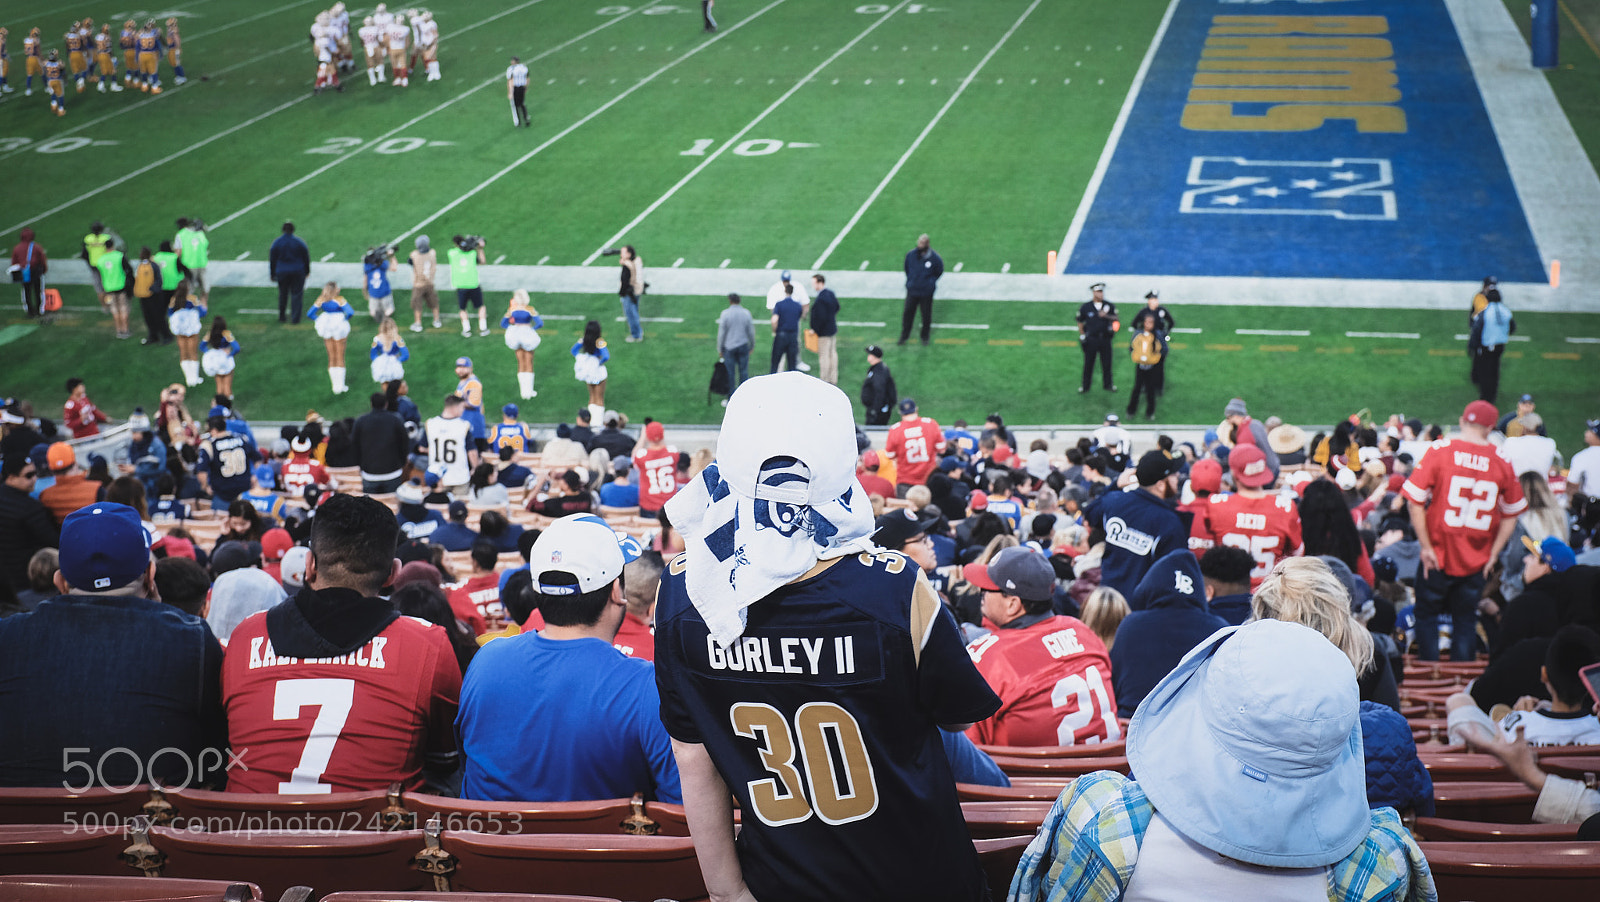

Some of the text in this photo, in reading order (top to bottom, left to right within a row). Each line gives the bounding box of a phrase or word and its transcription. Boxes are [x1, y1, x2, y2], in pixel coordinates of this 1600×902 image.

[1179, 15, 1408, 133] RAMS
[679, 138, 785, 157] 10
[219, 447, 247, 478] 30
[434, 438, 467, 464] 16
[904, 437, 930, 464] 21
[646, 466, 676, 495] 16
[1443, 475, 1499, 532] 52
[247, 636, 388, 669] KAICK
[707, 635, 856, 675] GURLEY II
[1051, 664, 1122, 747] 21
[273, 678, 355, 796] 7
[729, 701, 879, 826] 30
